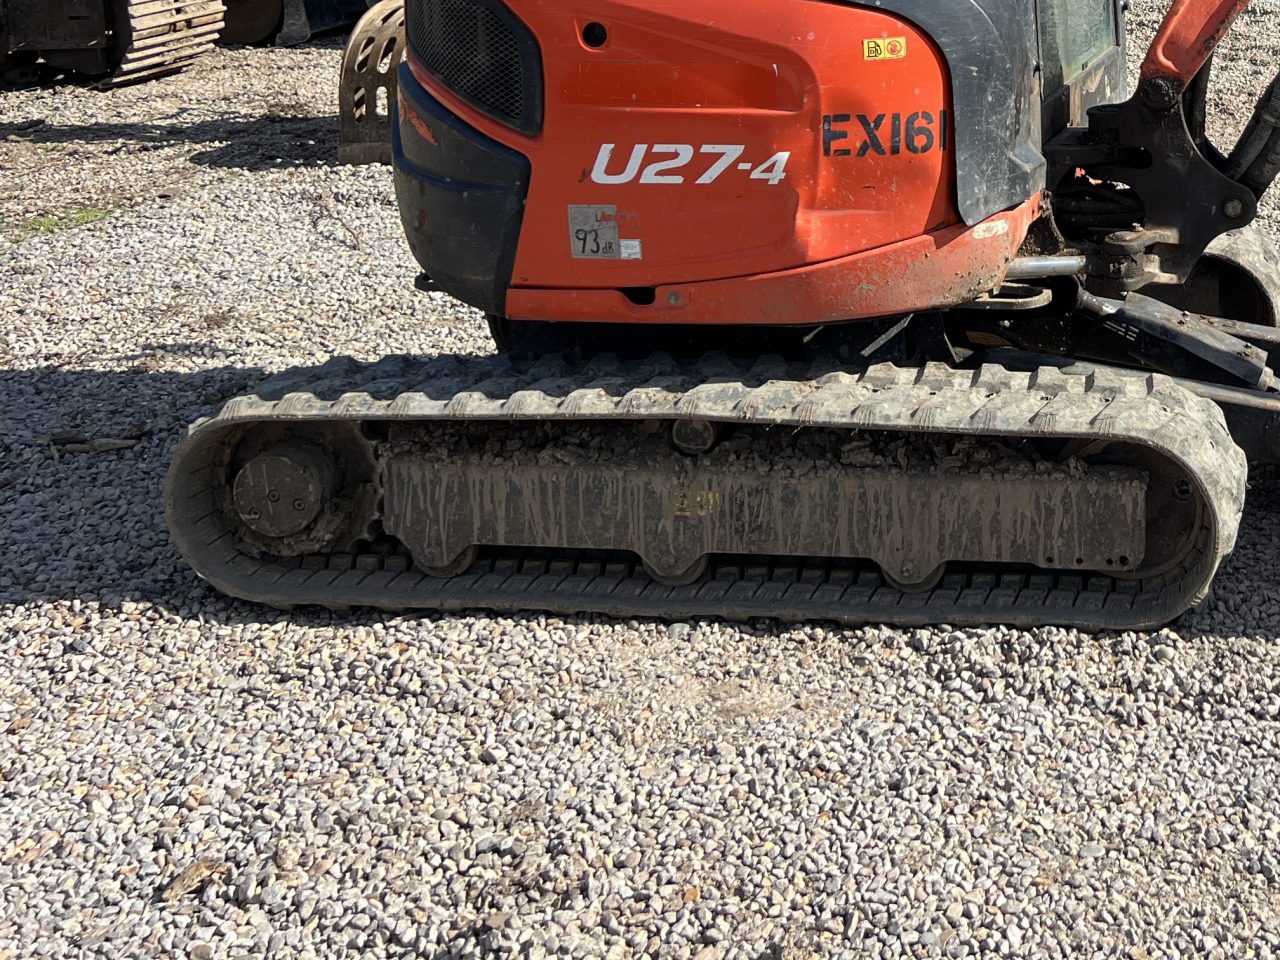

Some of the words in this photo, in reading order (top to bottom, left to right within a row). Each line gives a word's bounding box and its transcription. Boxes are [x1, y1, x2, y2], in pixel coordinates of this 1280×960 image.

[822, 109, 947, 157] EX161
[590, 144, 791, 184] U27-4
[575, 228, 600, 254] 93
